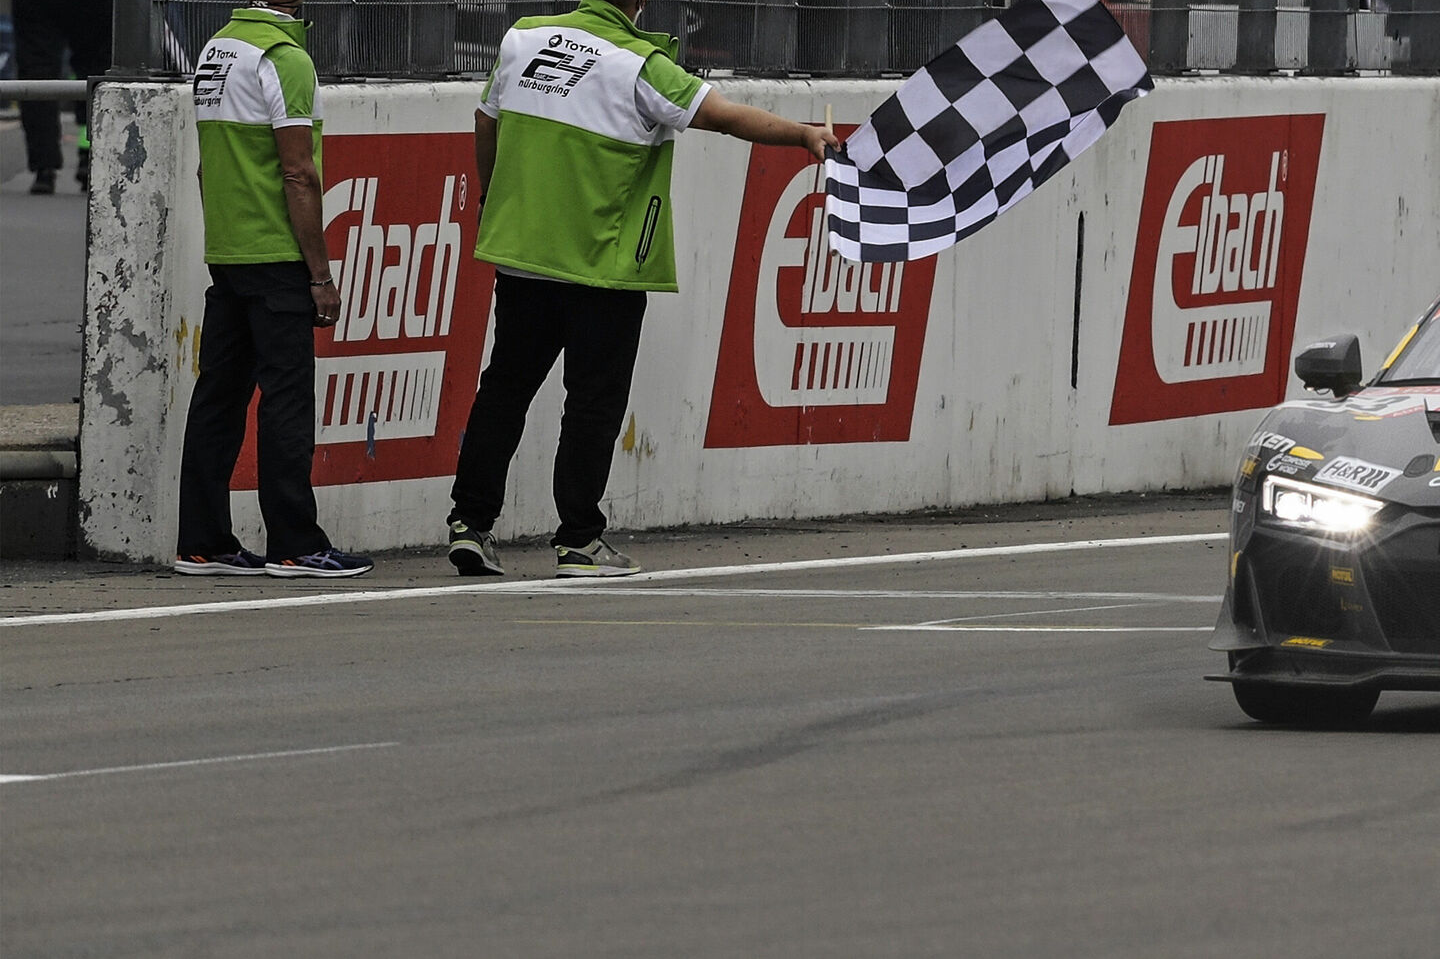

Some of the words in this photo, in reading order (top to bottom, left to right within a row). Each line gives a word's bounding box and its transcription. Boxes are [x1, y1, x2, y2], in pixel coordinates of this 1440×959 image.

[521, 48, 596, 88] 24
[518, 79, 571, 98] nürburgring
[1151, 151, 1285, 384] Eibach
